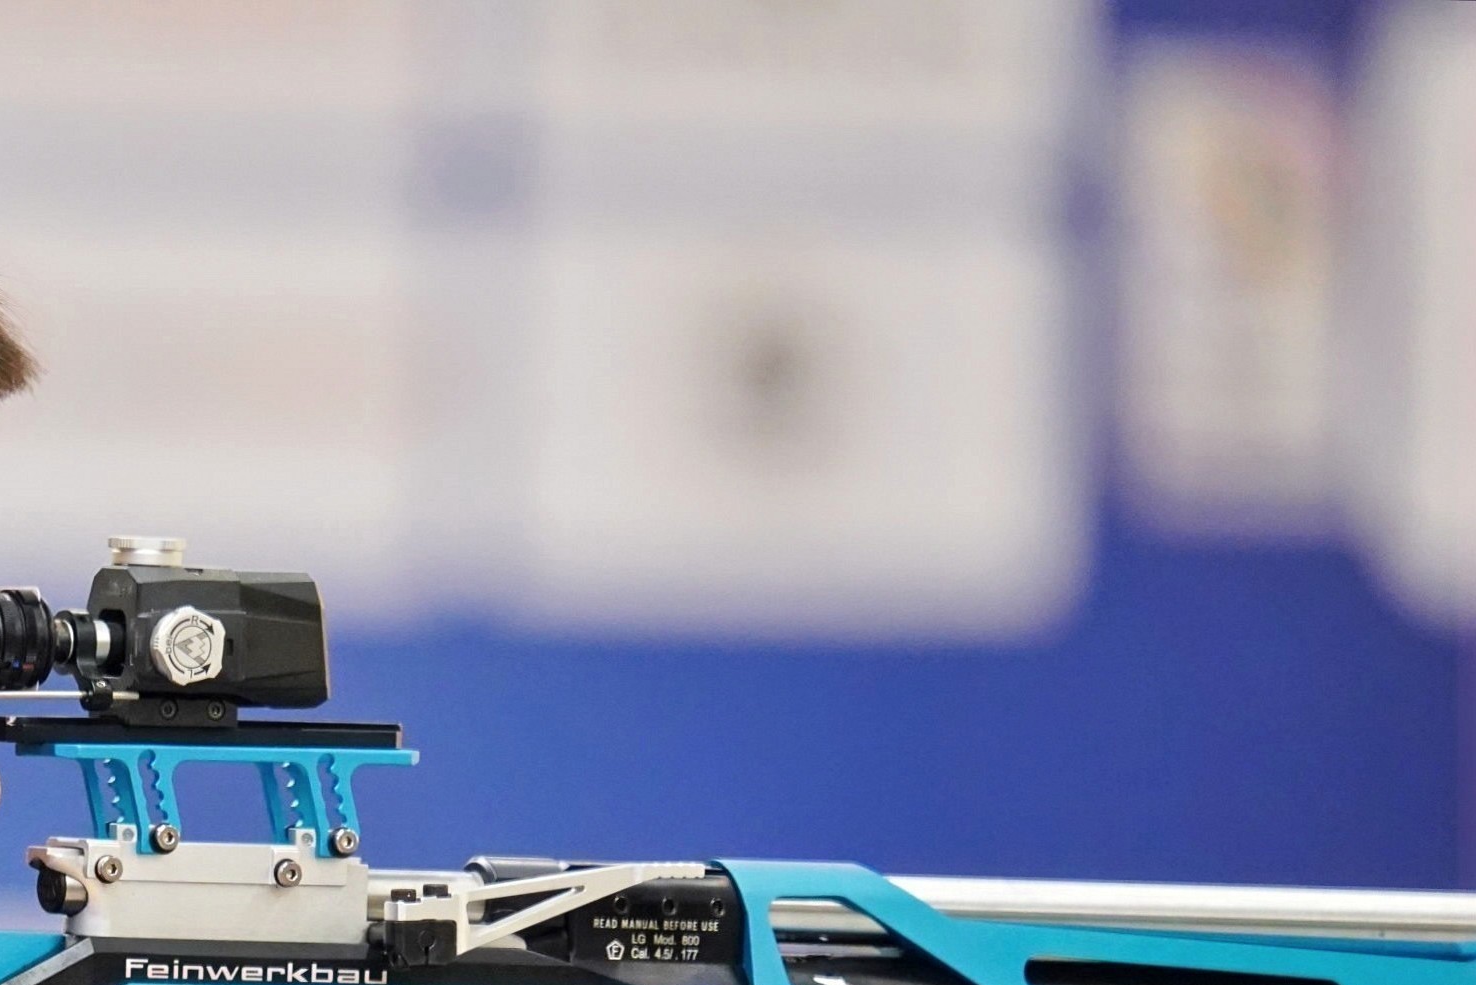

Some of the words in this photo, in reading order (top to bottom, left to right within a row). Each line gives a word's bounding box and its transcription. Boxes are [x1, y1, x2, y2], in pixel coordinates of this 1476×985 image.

[191, 615, 199, 625] R
[593, 918, 618, 929] READ
[621, 918, 659, 930] MANUAL
[663, 920, 698, 931] BEFORE
[701, 920, 719, 932] USE
[631, 933, 646, 945] LG
[653, 934, 676, 946] Mod.
[630, 947, 650, 959] Cal.
[125, 958, 388, 985] Feinwerkbau
